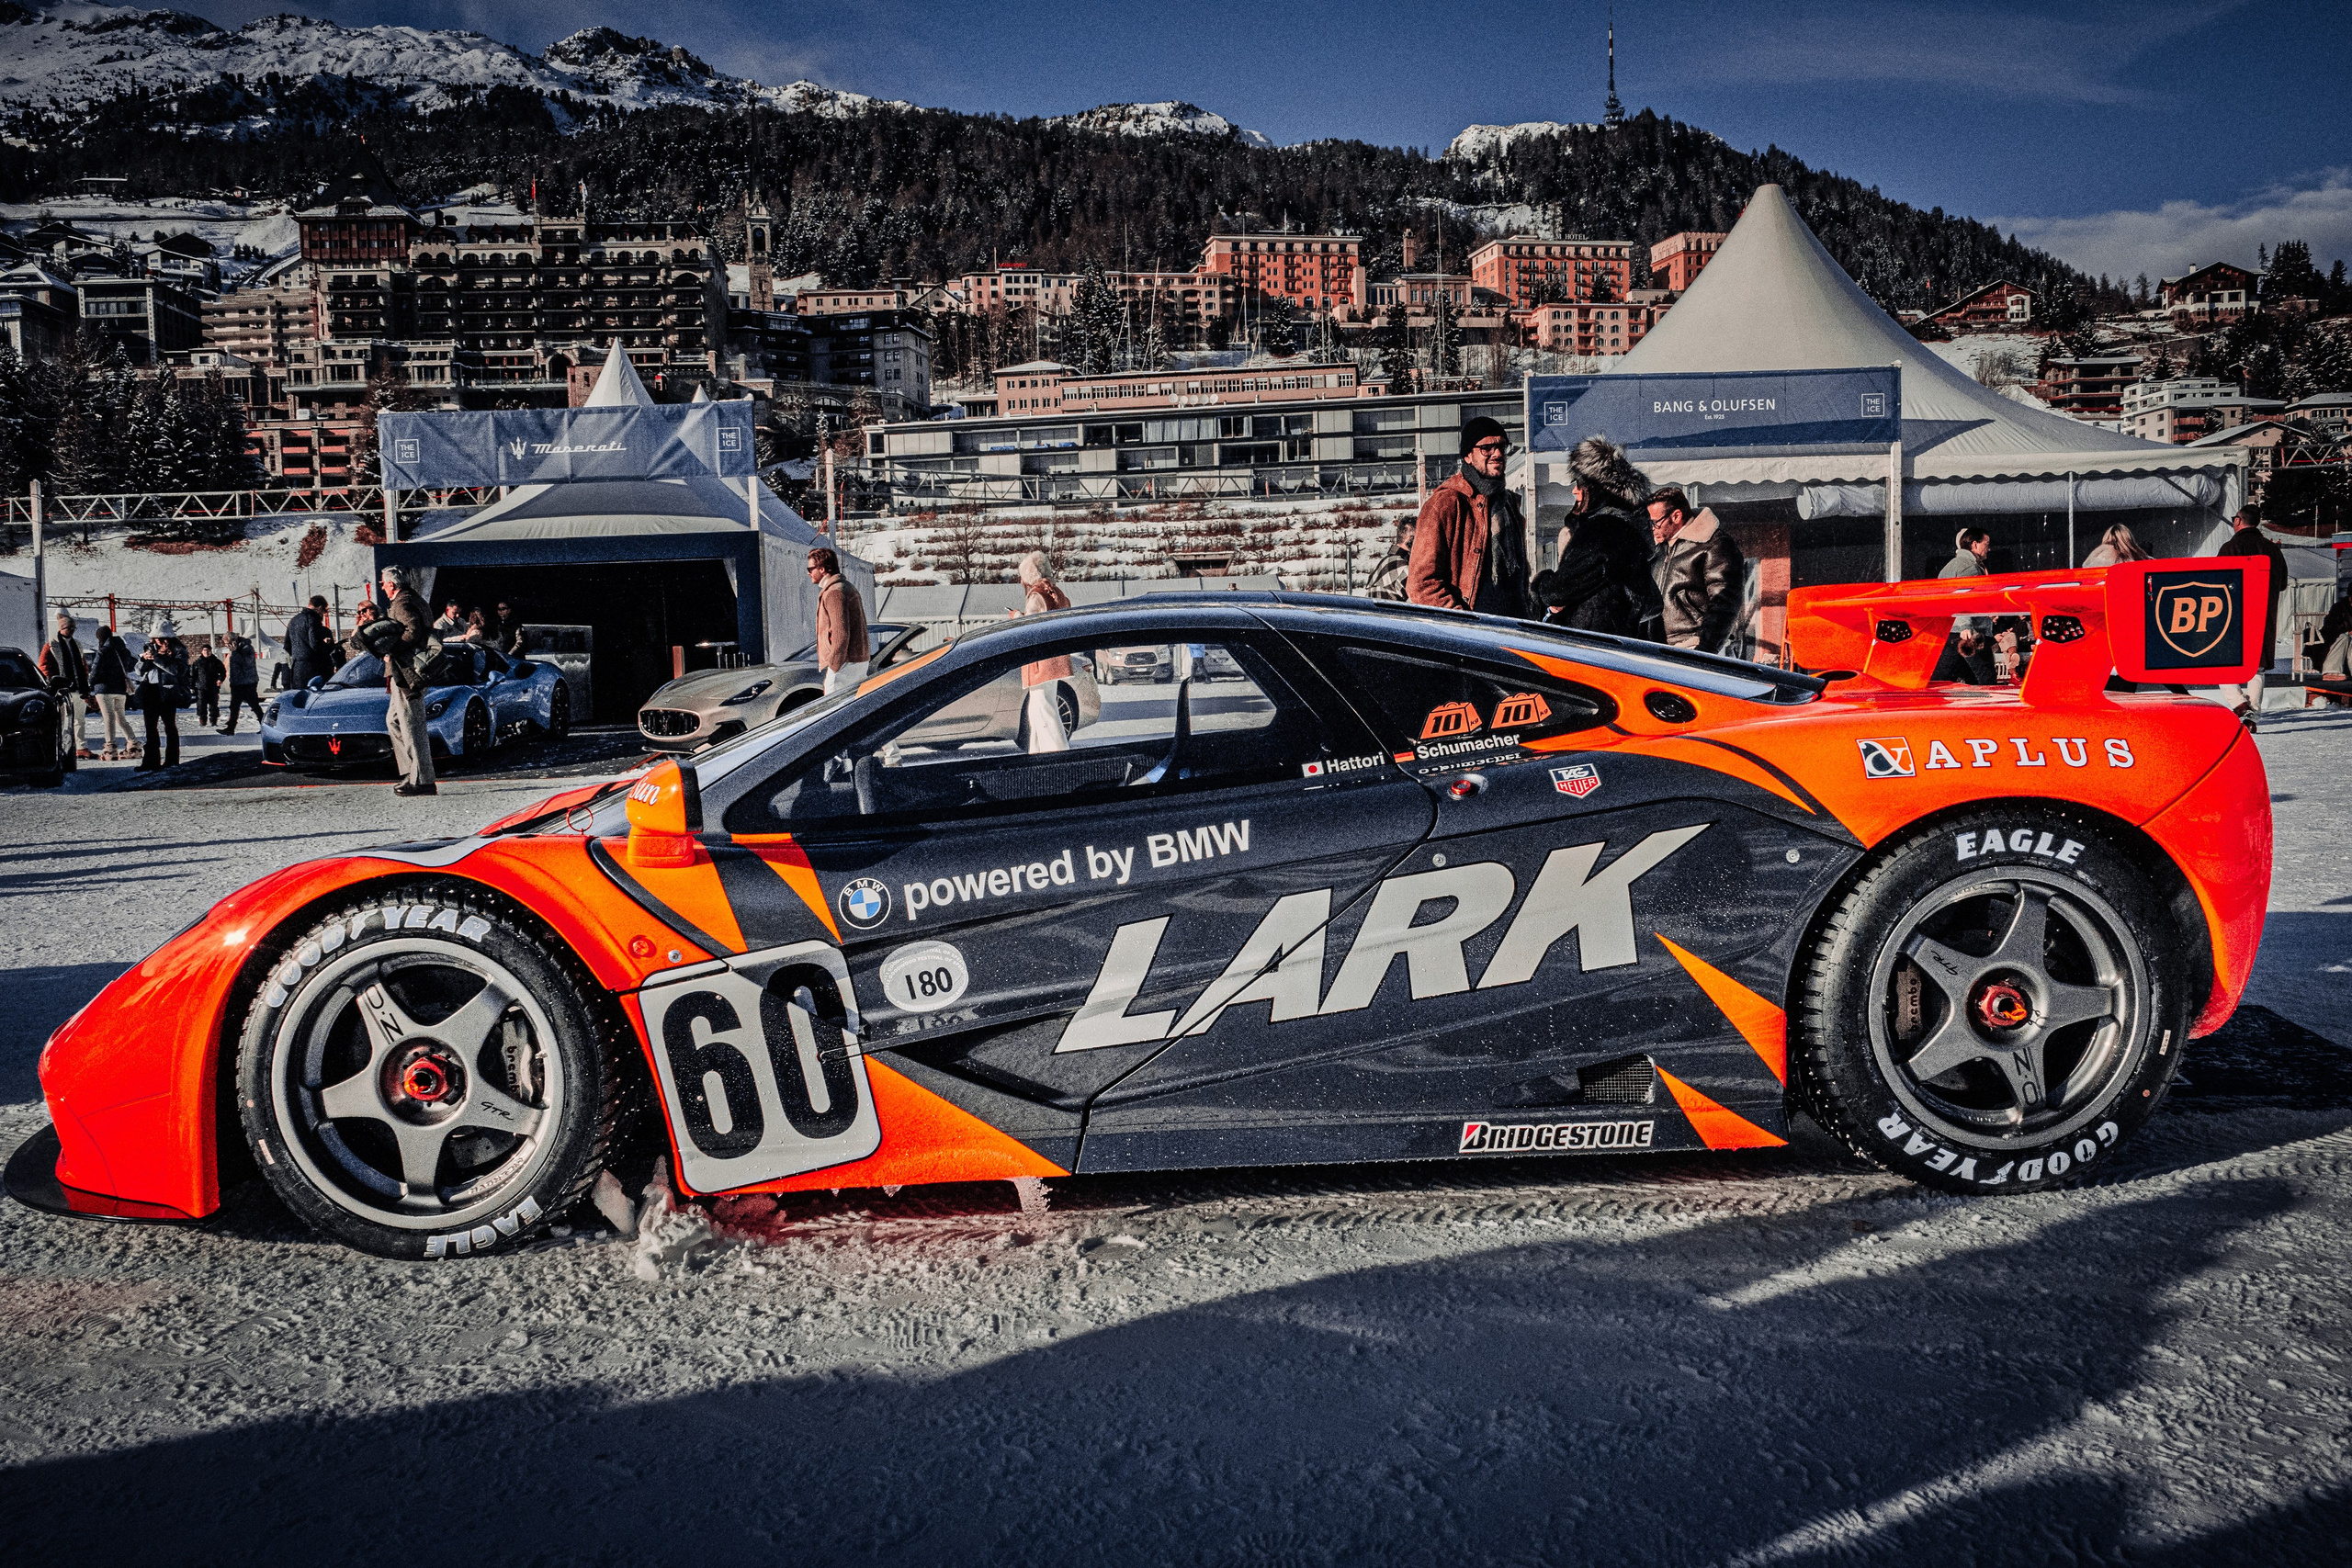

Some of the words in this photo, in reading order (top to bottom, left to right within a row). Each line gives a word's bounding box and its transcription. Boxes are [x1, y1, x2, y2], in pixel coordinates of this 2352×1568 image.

[1653, 400, 1693, 413] BANG
[1698, 400, 1708, 412] &
[1711, 399, 1776, 412] OLUFSEN
[530, 441, 628, 455] Maserati
[2169, 596, 2223, 634] BP
[1430, 713, 1463, 734] 10
[1470, 716, 1479, 727] kg
[1501, 704, 1532, 724] 10
[1539, 708, 1549, 717] kg
[1416, 734, 1521, 760] Schumacher
[1925, 737, 2135, 770] APLUS
[1325, 752, 1385, 774] Hattori
[1557, 767, 1589, 780] TAG
[1559, 778, 1597, 794] HEUER
[1956, 829, 2086, 864] EAGLE
[903, 849, 1075, 920] powered
[1086, 845, 1135, 886] by
[1147, 818, 1250, 869] BMW
[843, 880, 884, 897] BMW
[1054, 823, 1712, 1055] LARK
[905, 966, 954, 1000] 180
[1908, 978, 1920, 1032] brembo
[507, 1045, 520, 1094] bremb
[662, 962, 859, 1160] 60
[1461, 1122, 1653, 1151] BRIDGESTONE
[424, 1195, 544, 1258] EAGLE
